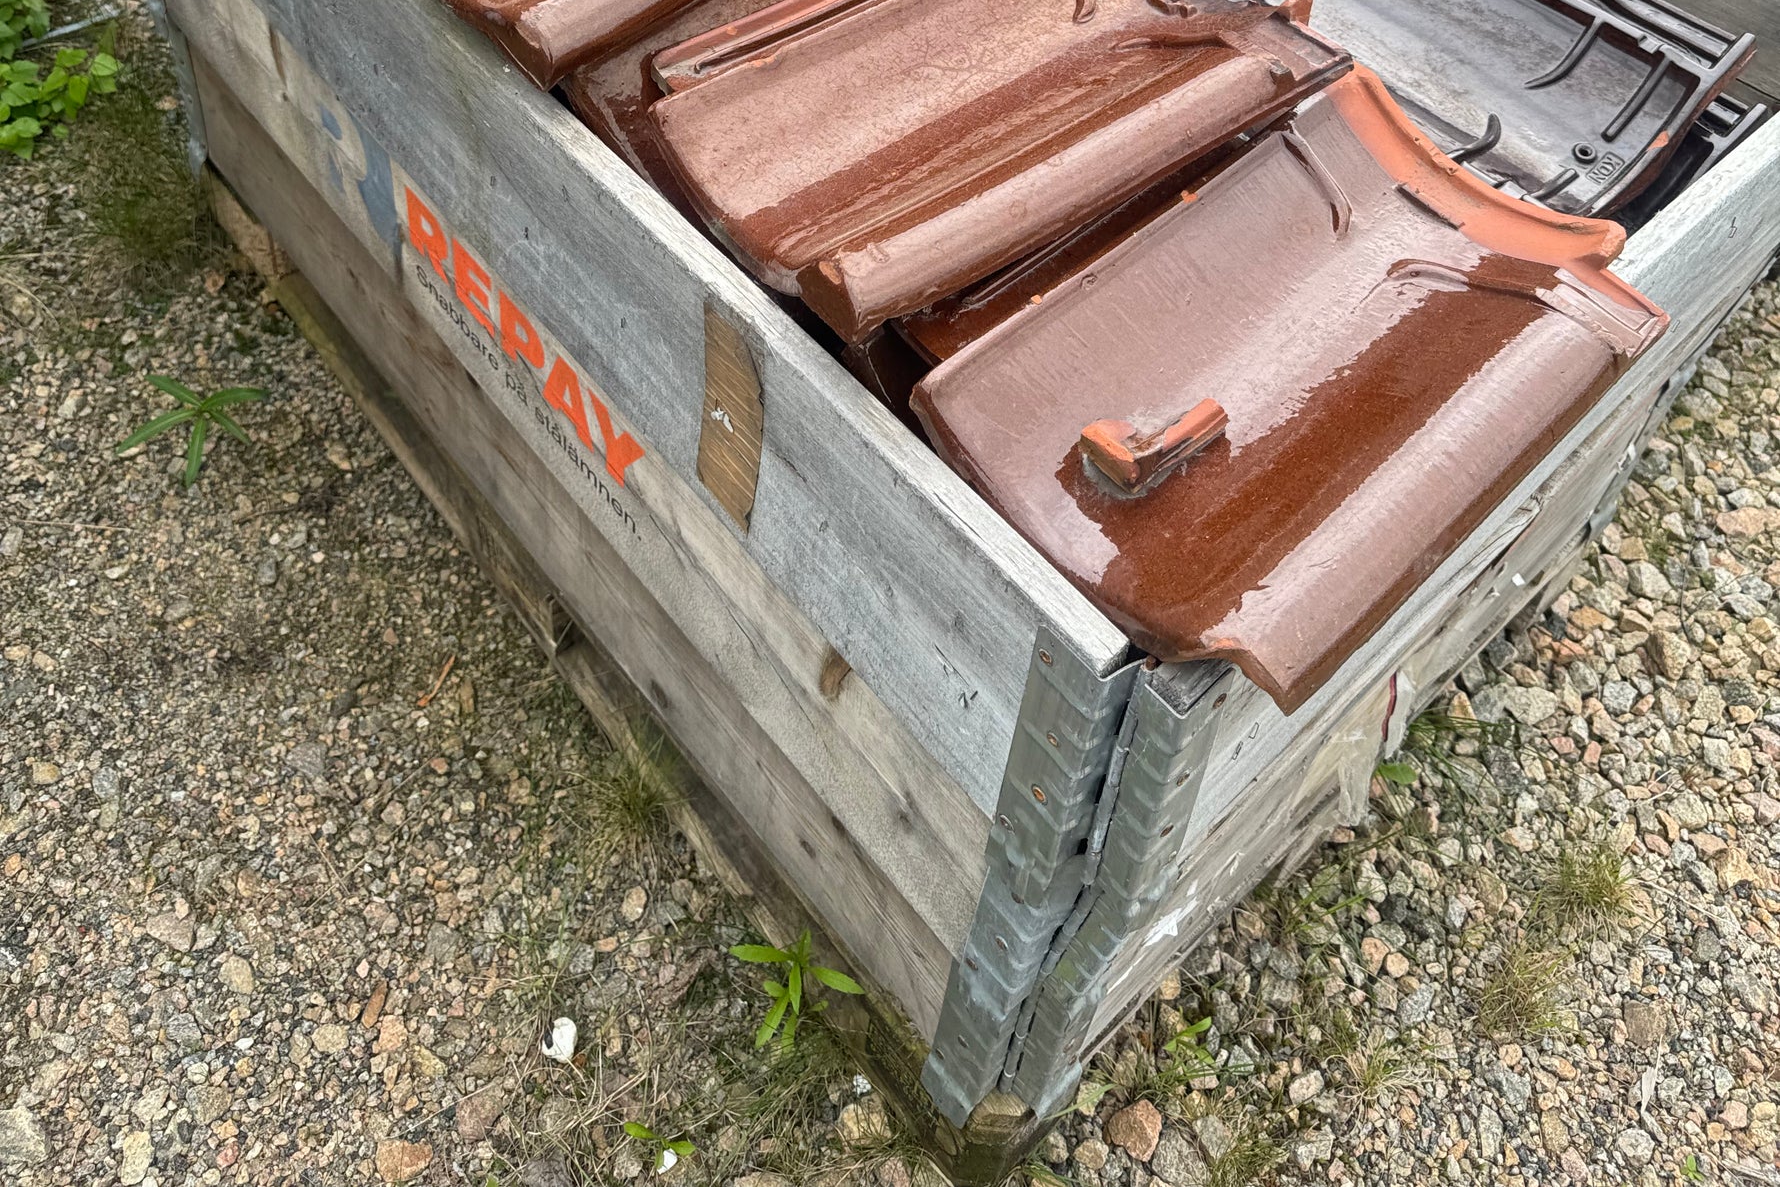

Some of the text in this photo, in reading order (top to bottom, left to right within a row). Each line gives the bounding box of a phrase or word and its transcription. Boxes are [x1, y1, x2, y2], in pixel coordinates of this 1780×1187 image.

[405, 186, 646, 489] REPAY
[416, 265, 642, 541] Snabbare på stålämnen.
